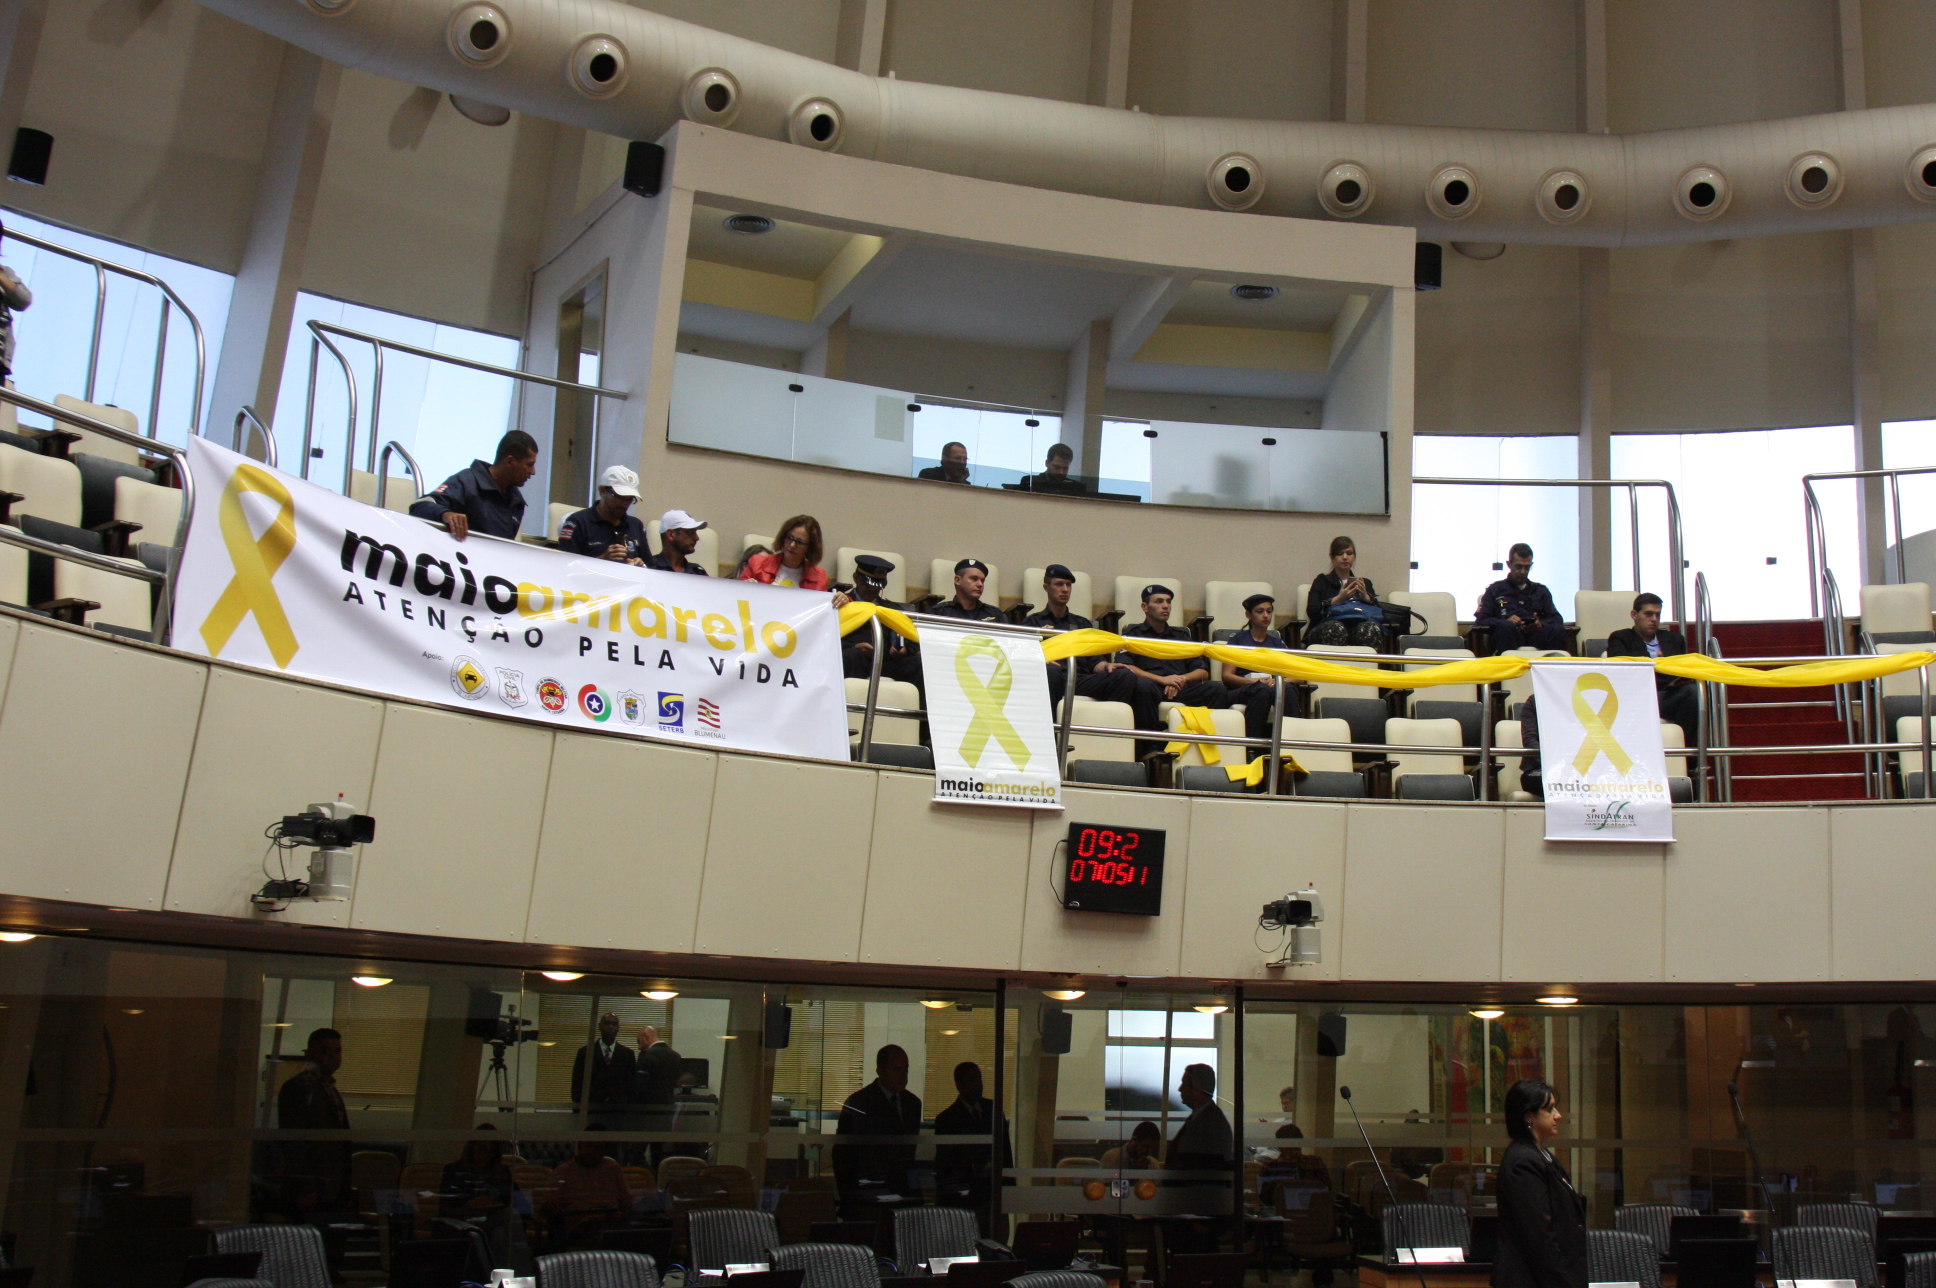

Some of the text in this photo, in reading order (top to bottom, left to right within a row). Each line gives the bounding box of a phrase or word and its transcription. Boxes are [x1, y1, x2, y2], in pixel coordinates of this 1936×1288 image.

[344, 581, 799, 688] ATENÇÃO PELA VIDA
[658, 725, 684, 734] SETERB
[694, 730, 726, 740] BLUMENAU
